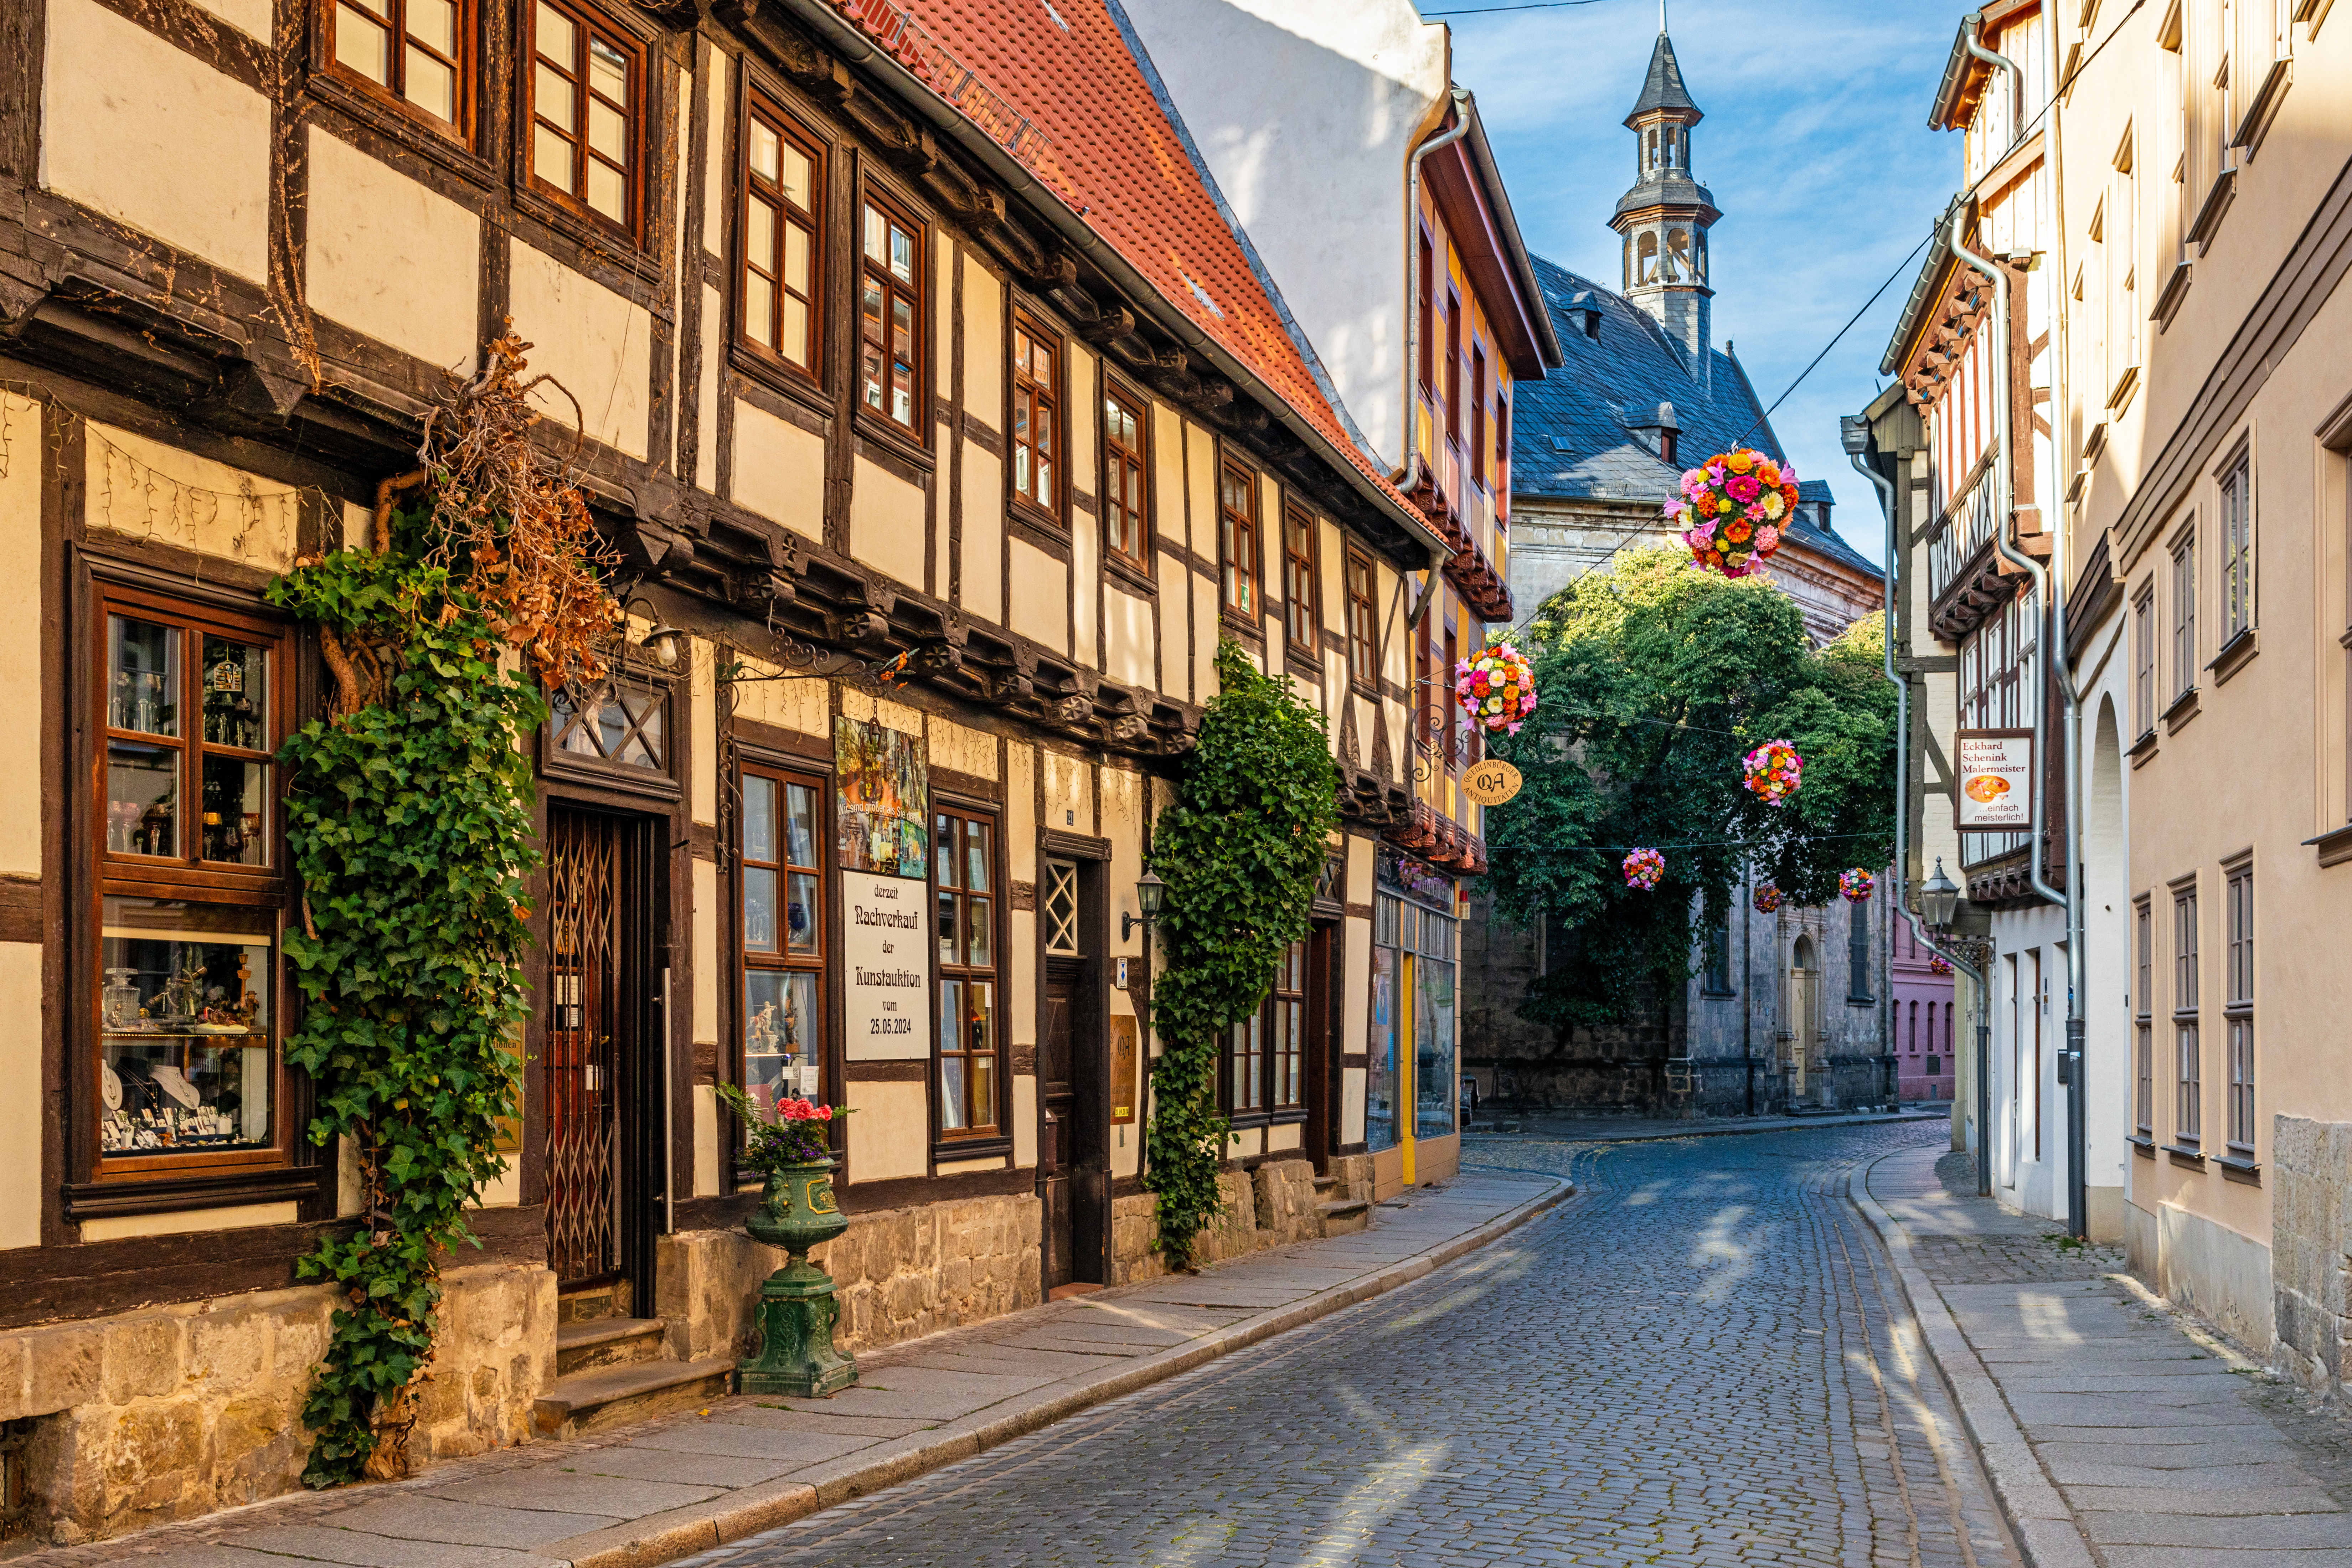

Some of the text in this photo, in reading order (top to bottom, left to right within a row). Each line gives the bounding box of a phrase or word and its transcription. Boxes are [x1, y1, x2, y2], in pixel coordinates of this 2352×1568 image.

[1962, 741, 2002, 751] Eckhard
[1962, 753, 2007, 762] Schenink
[1464, 762, 1518, 783] QUEDLINBURGER
[1962, 764, 2026, 773] Malermeister
[1477, 773, 1505, 793] QA
[1464, 783, 1519, 804] ANTIQUITÄTEN
[1980, 804, 2018, 812] ...einfach
[837, 801, 927, 831] Wir sind größer als Sie denken!
[1068, 812, 1073, 824] 21
[1975, 813, 2023, 821] meisterlich!
[874, 884, 898, 899] derzeit
[855, 905, 918, 929] Nachverkauf
[882, 940, 894, 954] der
[856, 966, 920, 987] Kunstauktion
[882, 1001, 897, 1011] vom
[871, 1018, 911, 1034] 25.05.2024
